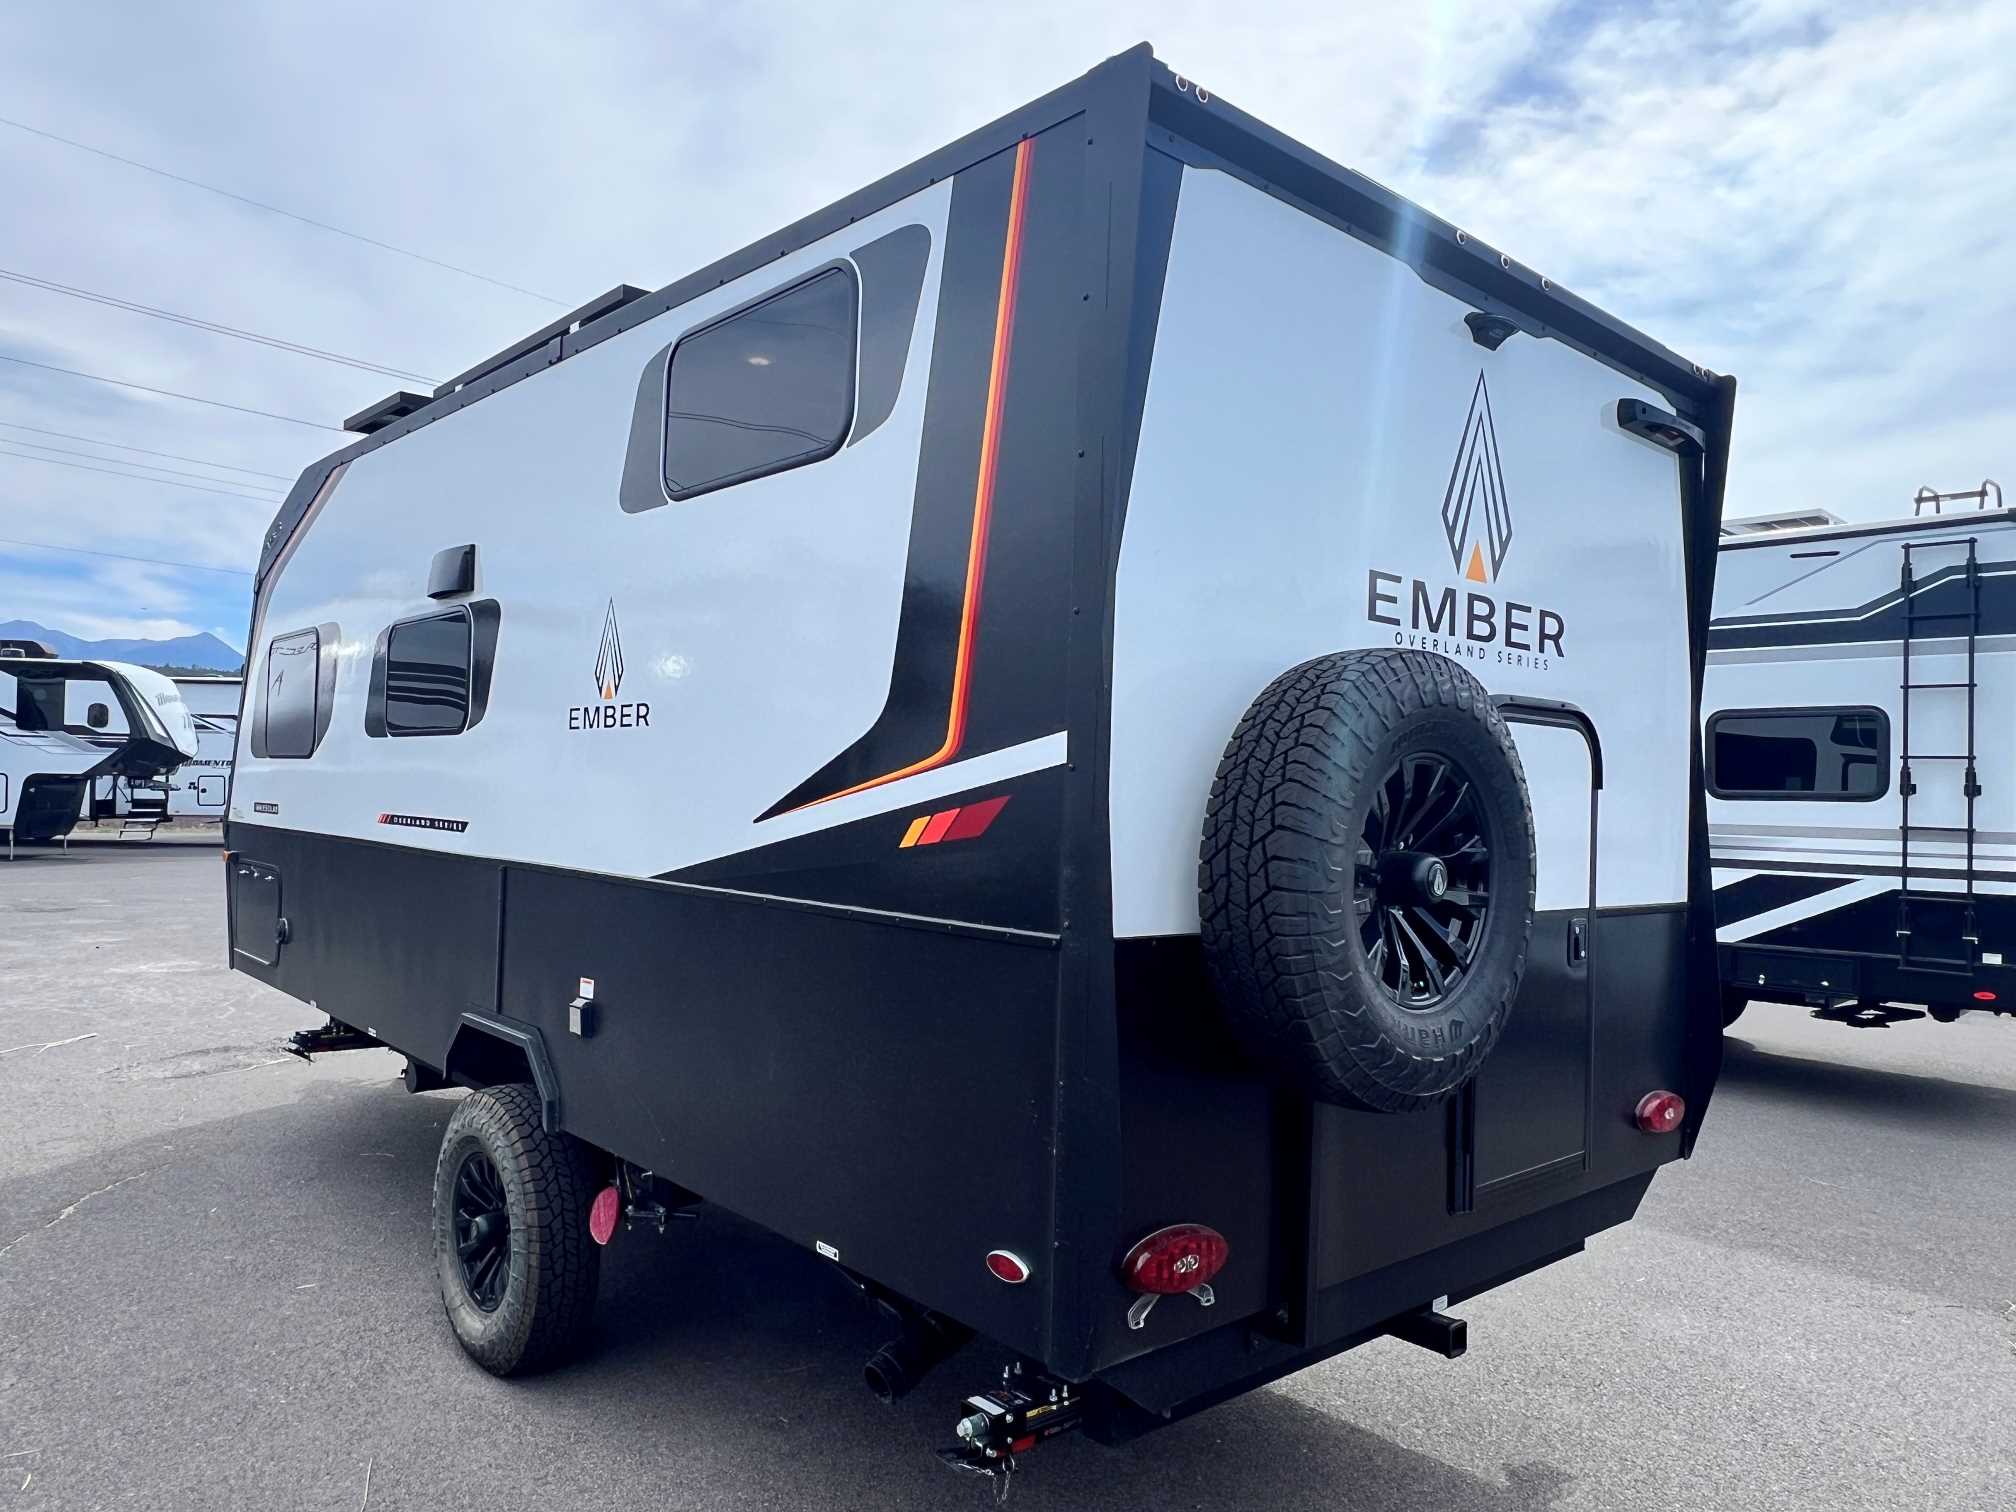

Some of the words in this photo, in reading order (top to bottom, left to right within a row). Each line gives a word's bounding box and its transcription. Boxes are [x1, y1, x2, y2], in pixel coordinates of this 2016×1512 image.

[1368, 569, 1565, 657] EMBER
[1394, 631, 1486, 660] OVERLAND
[1497, 651, 1549, 670] SERIES
[568, 703, 650, 730] EMBER
